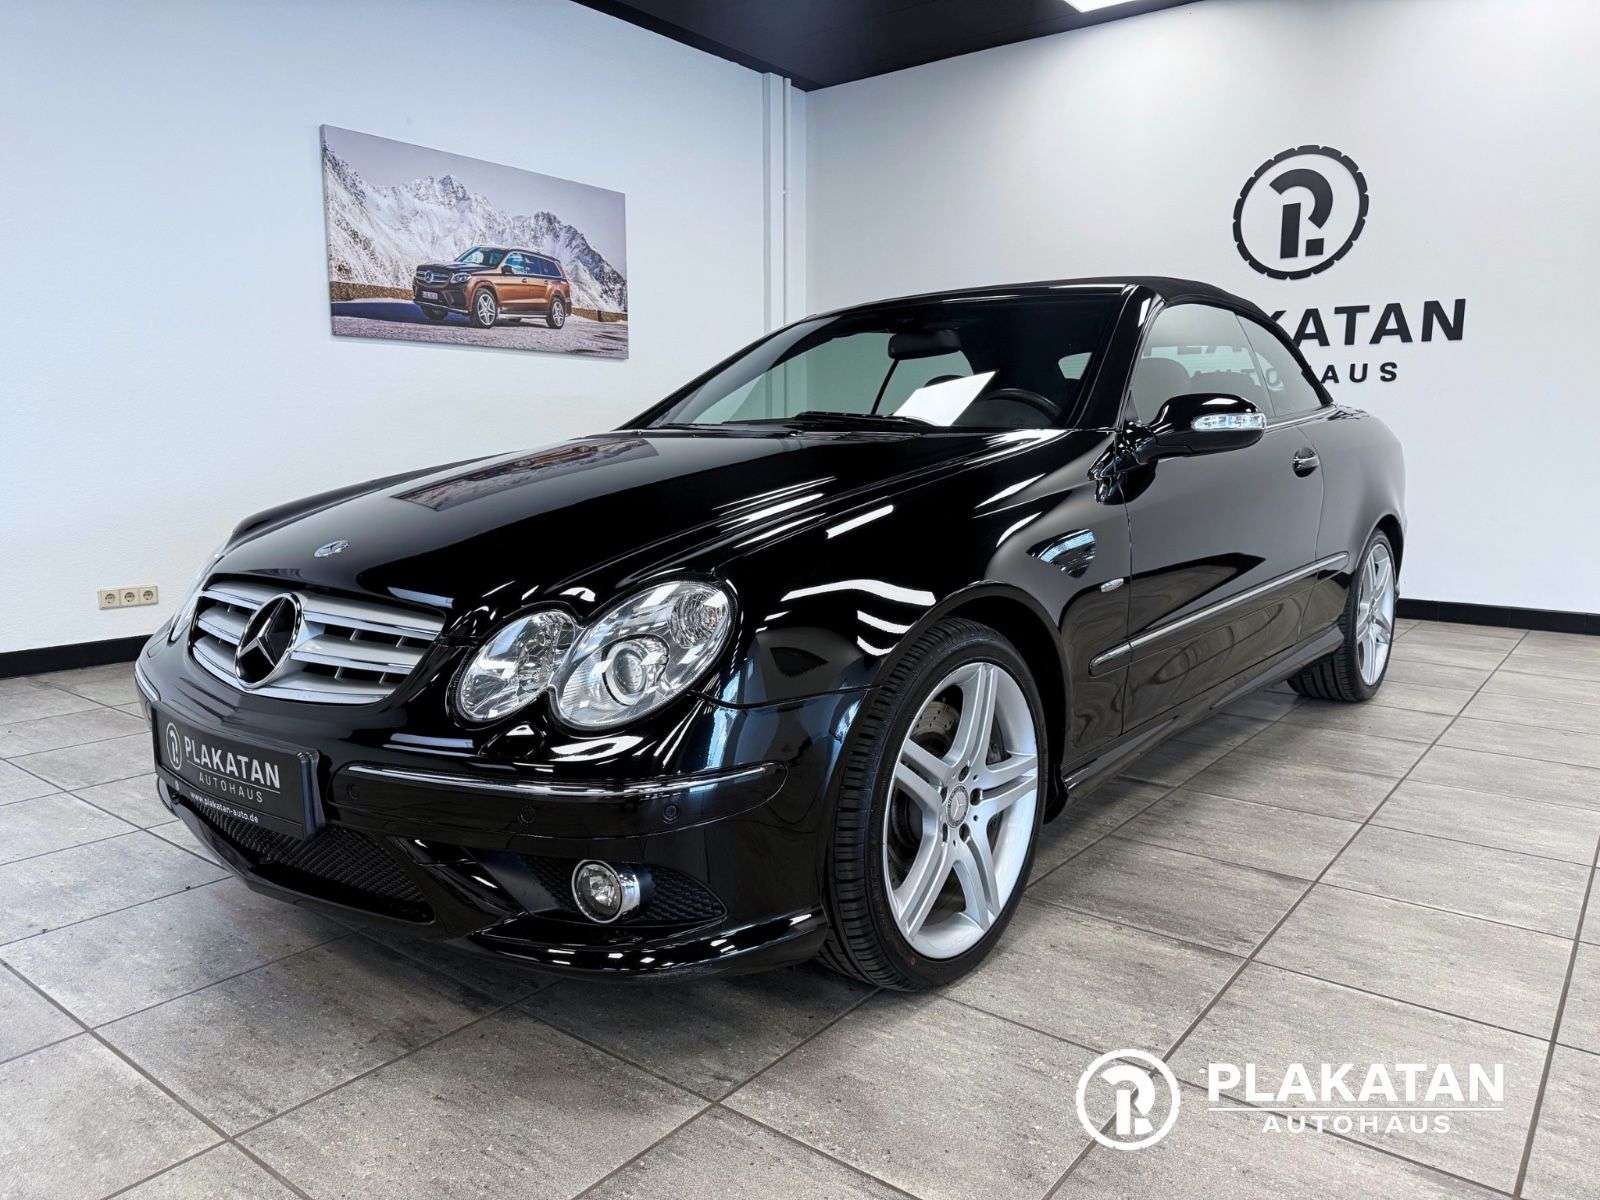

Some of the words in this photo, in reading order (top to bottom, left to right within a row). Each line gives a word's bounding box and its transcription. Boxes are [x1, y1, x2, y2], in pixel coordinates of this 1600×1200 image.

[1269, 298, 1466, 347] ATAN
[1309, 361, 1398, 384] AUS
[184, 735, 280, 789] PLAKATAN
[200, 771, 263, 803] AUTOHAUS
[190, 791, 259, 824] www.plakatan-auto.de
